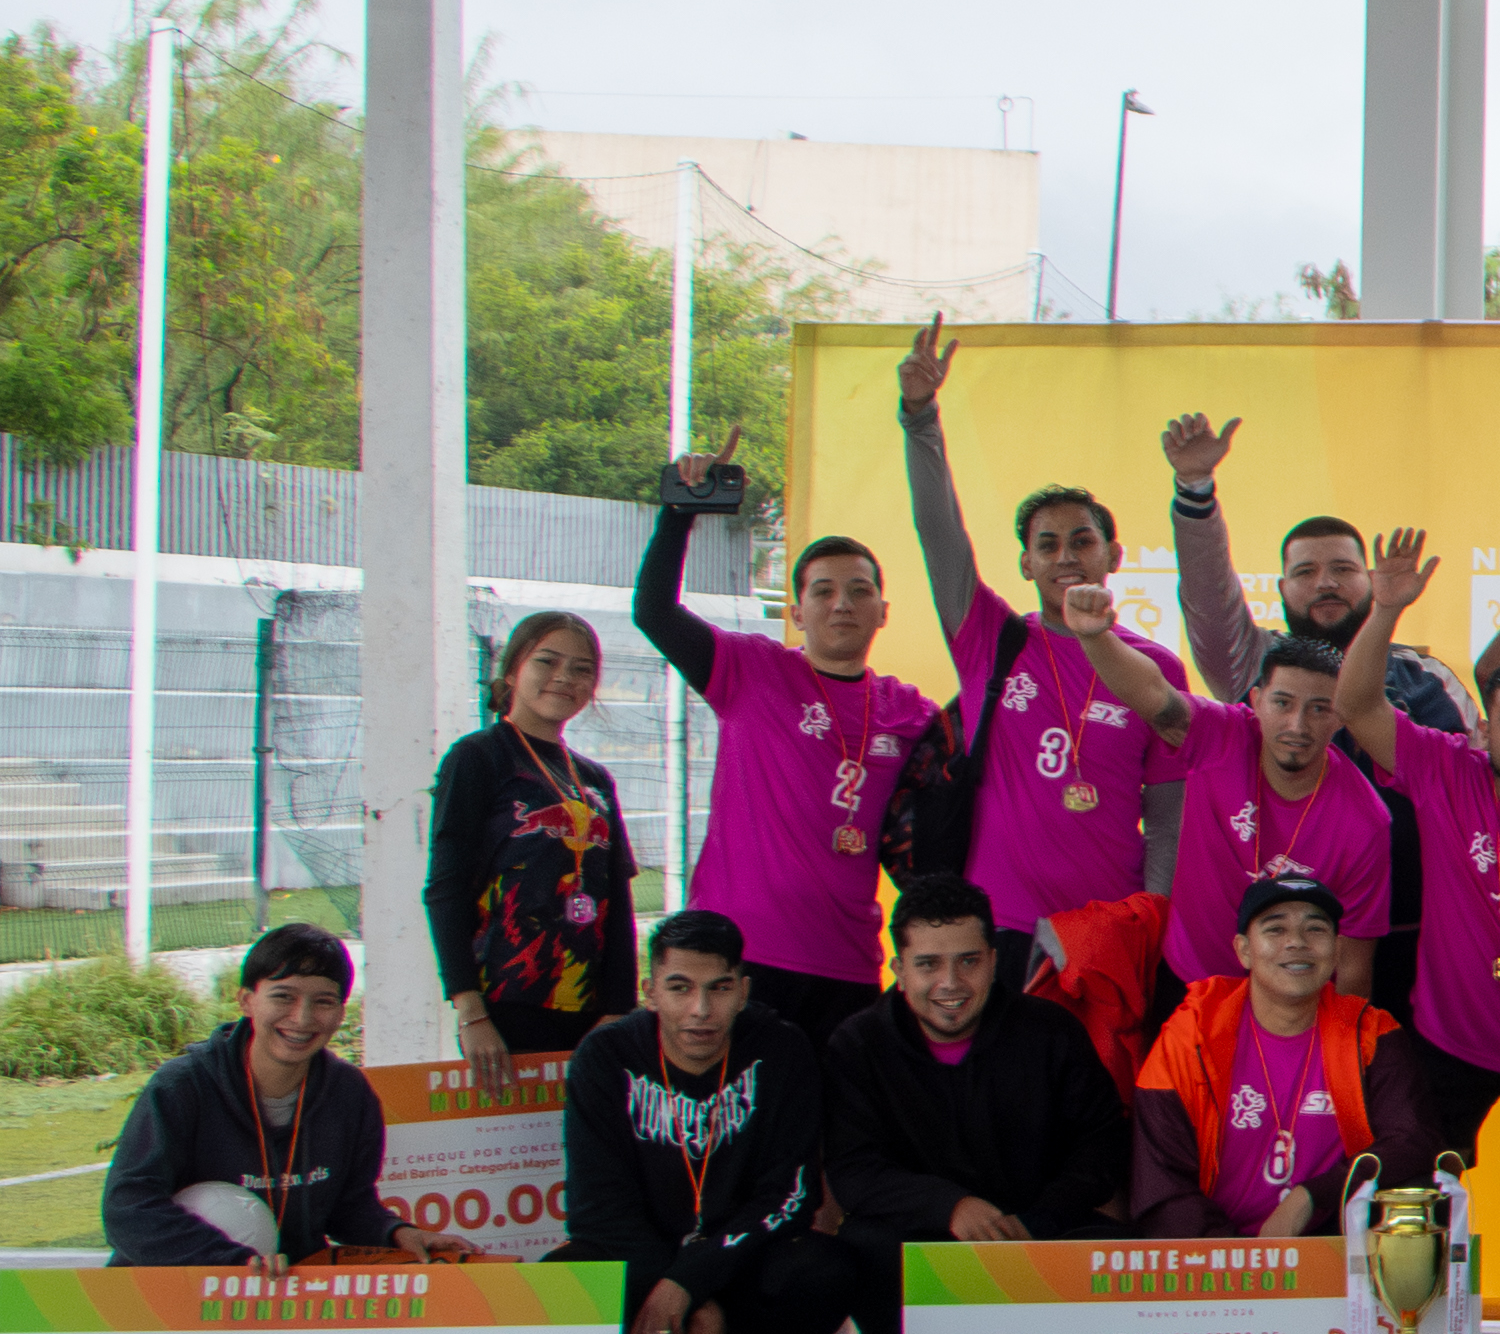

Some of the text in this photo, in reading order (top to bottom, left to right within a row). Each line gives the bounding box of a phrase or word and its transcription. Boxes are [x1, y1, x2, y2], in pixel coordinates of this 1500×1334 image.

[1036, 727, 1071, 779] 3
[831, 760, 867, 812] 2
[410, 1167, 448, 1180] Barrio
[523, 1158, 561, 1172] Mayor
[1091, 1247, 1299, 1272] PONTE NUEVO
[203, 1274, 428, 1297] PONTE NUEVO
